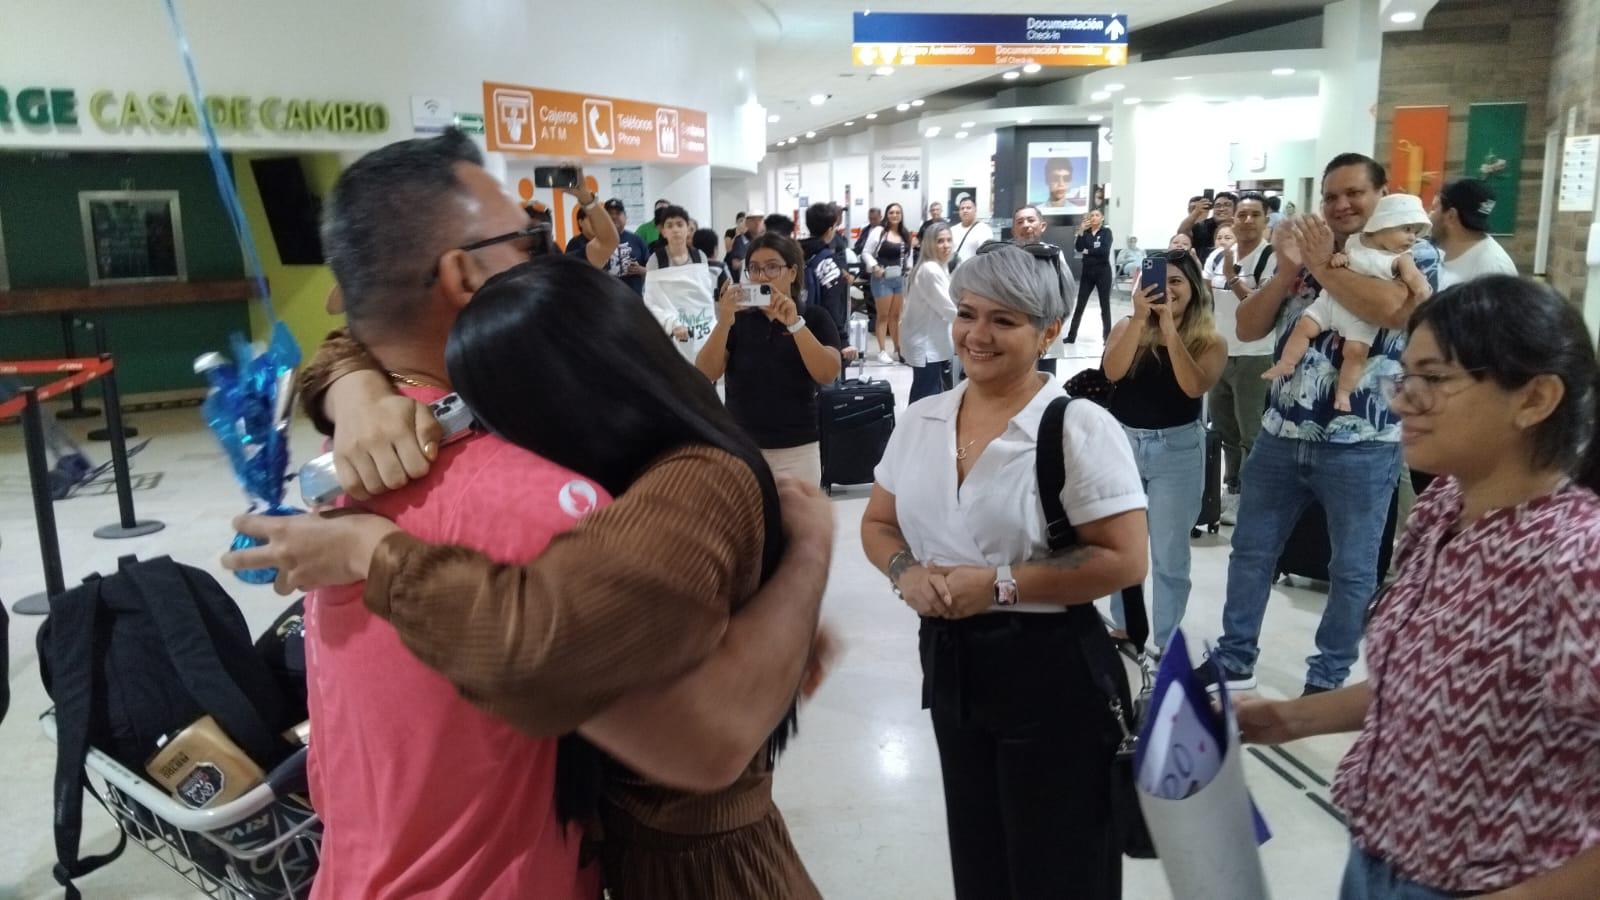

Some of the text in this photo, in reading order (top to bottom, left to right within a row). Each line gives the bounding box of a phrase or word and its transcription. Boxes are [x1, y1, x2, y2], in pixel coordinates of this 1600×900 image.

[1027, 17, 1103, 30] Documentación
[89, 90, 198, 129] CASA
[259, 96, 390, 133] CAMBIO
[540, 105, 578, 126] Cajeros
[618, 132, 641, 146] Phone
